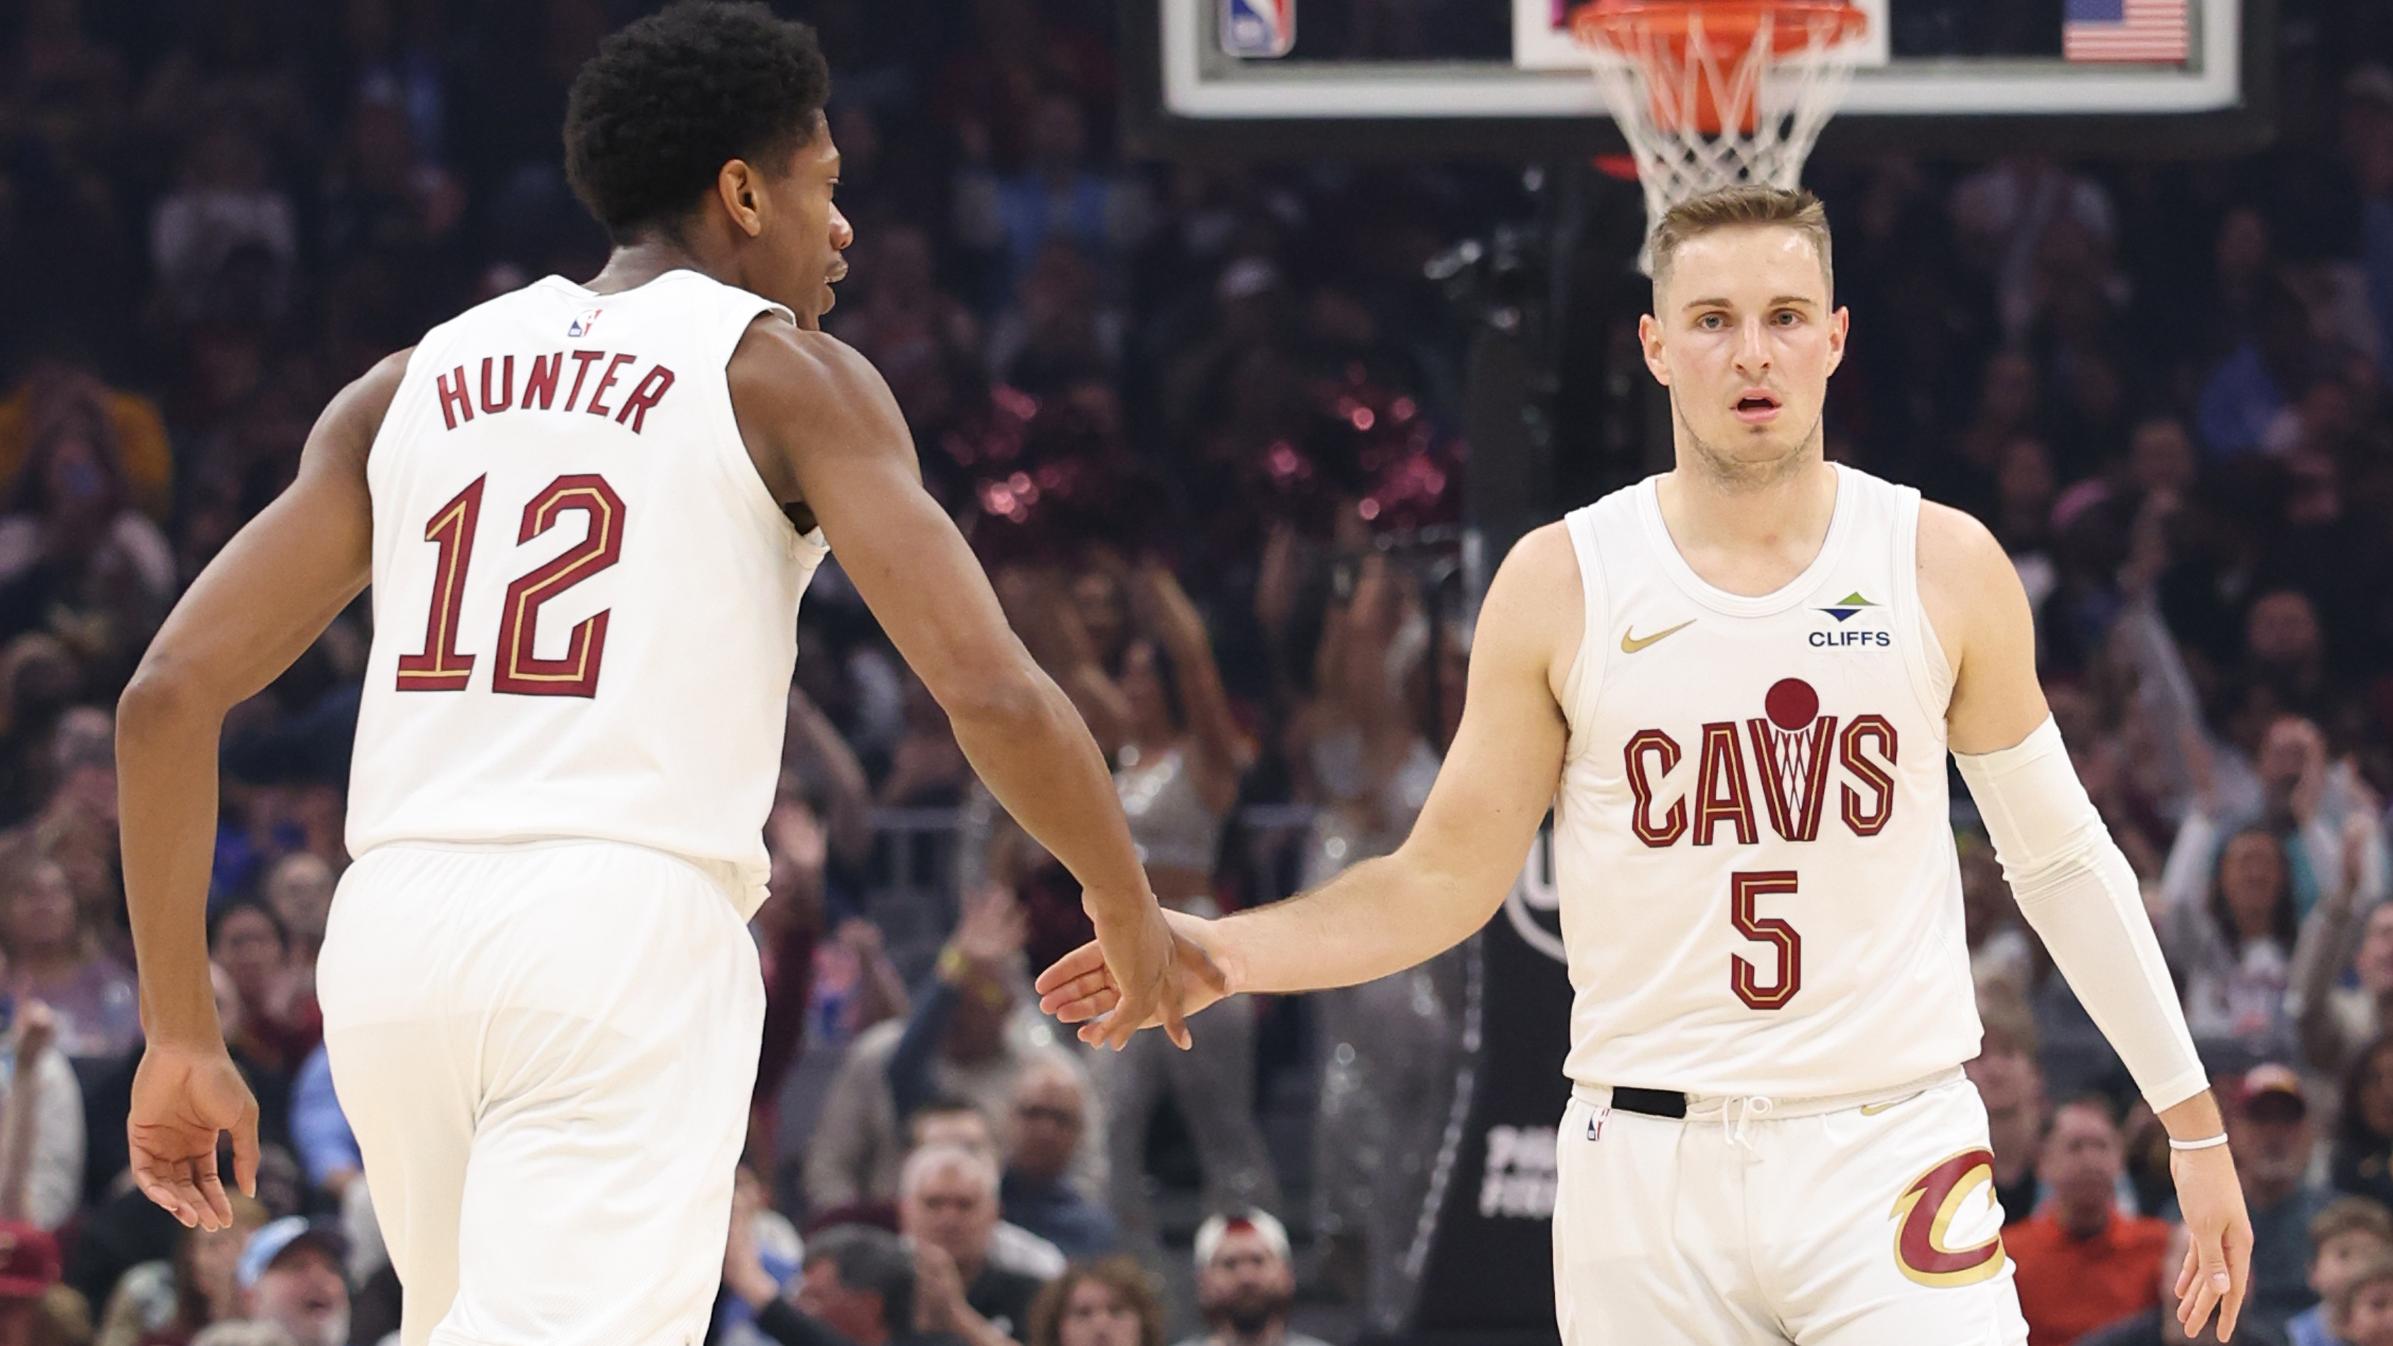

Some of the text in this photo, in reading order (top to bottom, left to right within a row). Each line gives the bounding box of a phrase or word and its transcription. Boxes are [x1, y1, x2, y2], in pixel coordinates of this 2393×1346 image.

[436, 350, 676, 435] HUNTER
[395, 471, 626, 700] 12
[1808, 630, 1891, 648] CLIFFS
[1623, 713, 1899, 848] CAVS
[1730, 870, 1802, 1011] 5
